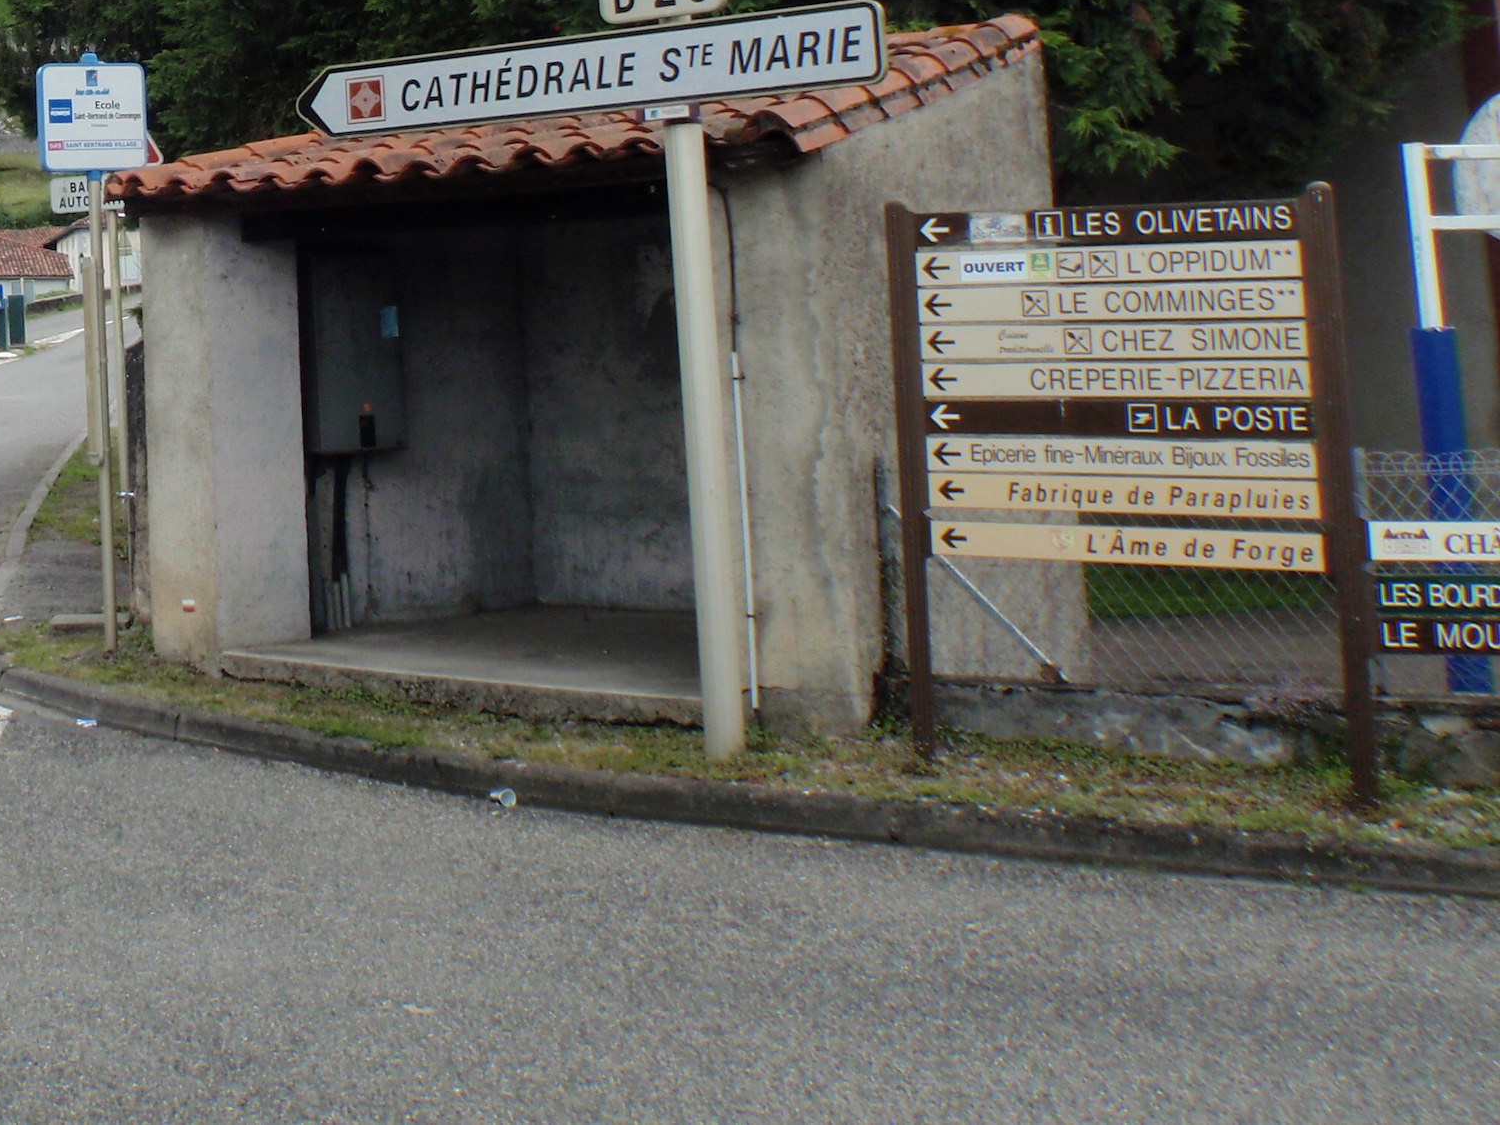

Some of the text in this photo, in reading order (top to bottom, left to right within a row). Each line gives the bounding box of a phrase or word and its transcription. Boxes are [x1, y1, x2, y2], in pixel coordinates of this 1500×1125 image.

[401, 25, 861, 111] CATHÉDRALE STE MARIE
[95, 100, 121, 110] Ecole
[1071, 205, 1293, 236] LES OLIVETAINS
[963, 261, 1025, 274] OUVERT
[1058, 291, 1088, 314] LE
[1102, 327, 1301, 352] CHEZ SIMONE
[1030, 368, 1305, 391] CREPERIE-PIZZERIA
[1164, 406, 1309, 431] LA POSTE
[970, 444, 1036, 466] Epicerie
[1171, 446, 1227, 469] Bijoux
[1234, 447, 1311, 468] Fossiles
[1008, 481, 1310, 513] Fabrique de Parapluies
[1085, 529, 1314, 568] L'Âme de Forge
[1378, 582, 1423, 608] LES
[1380, 621, 1500, 650] LE MOU
